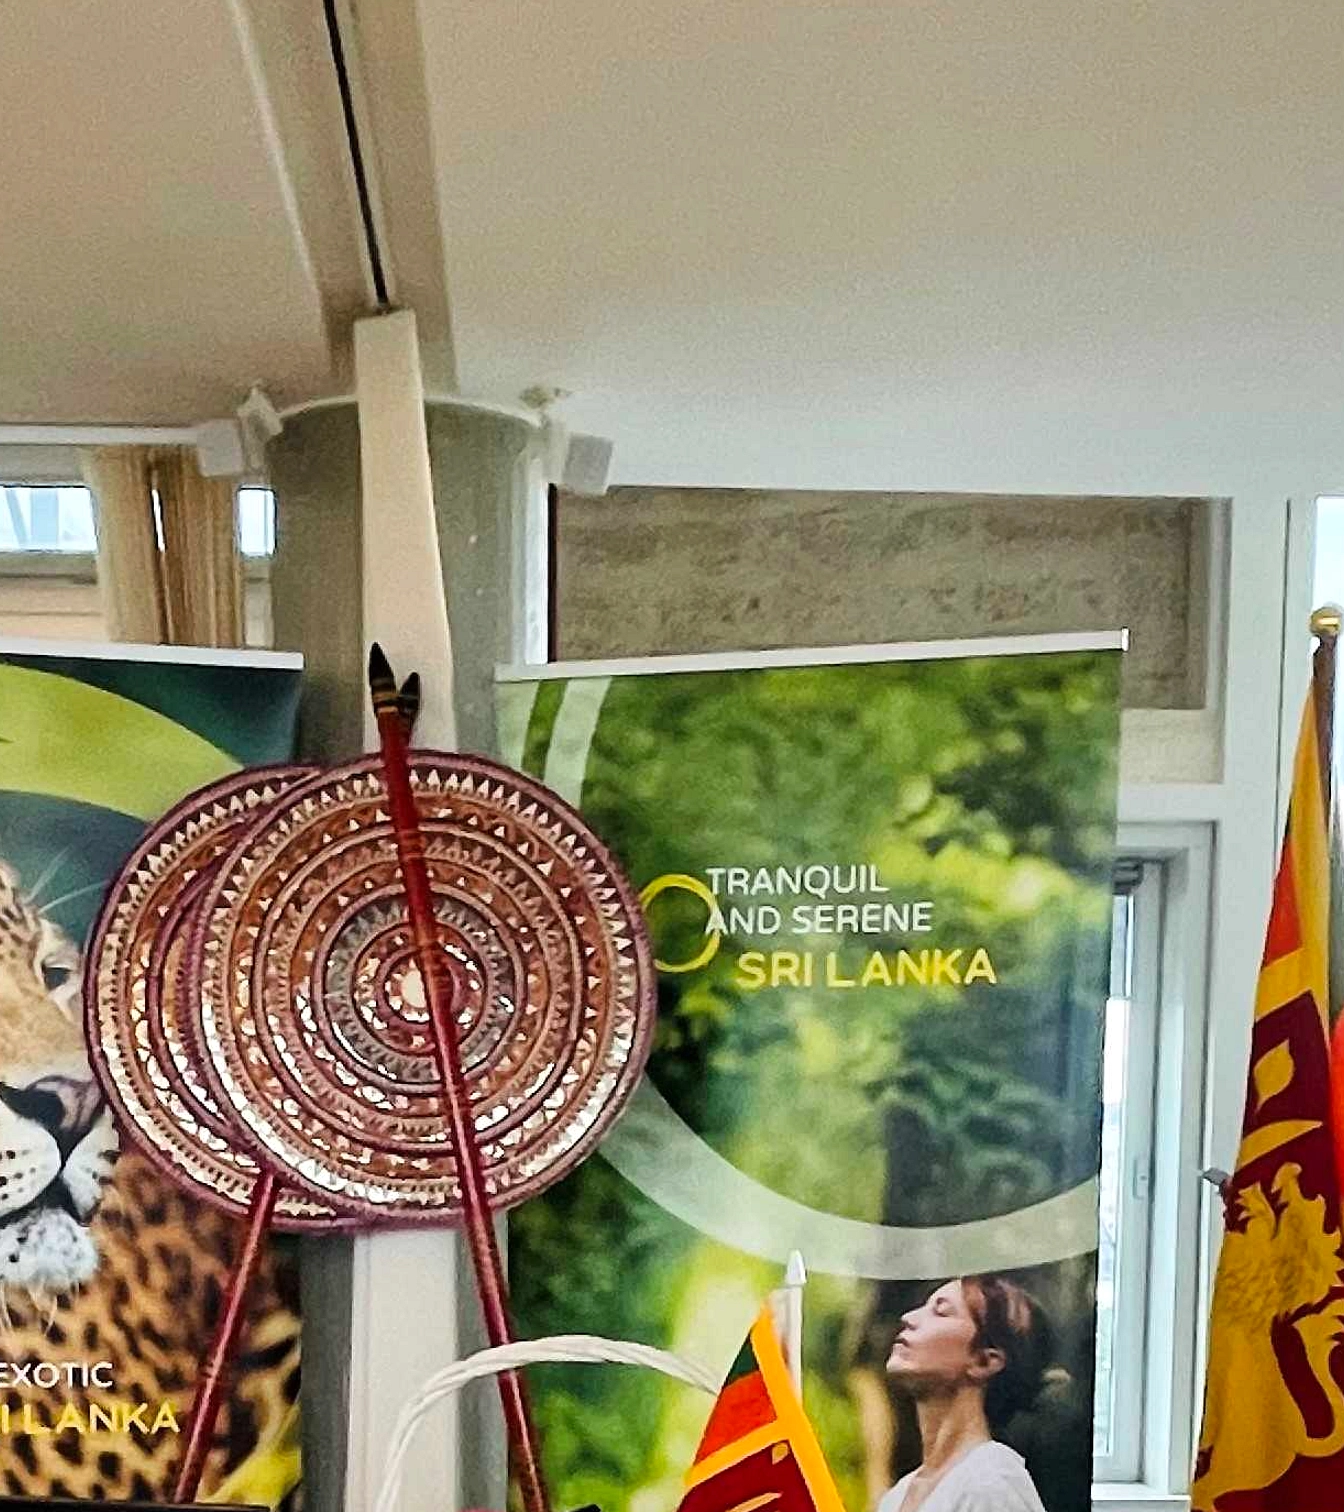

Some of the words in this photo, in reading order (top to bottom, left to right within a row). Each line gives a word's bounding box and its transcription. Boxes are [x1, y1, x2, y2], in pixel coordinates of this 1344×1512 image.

[705, 864, 889, 900] TRANQUIL
[705, 905, 782, 937] AND
[791, 902, 934, 935] SERENE
[735, 951, 813, 989] SRI
[826, 949, 997, 988] LANKA
[24, 1402, 181, 1434] LANKA
